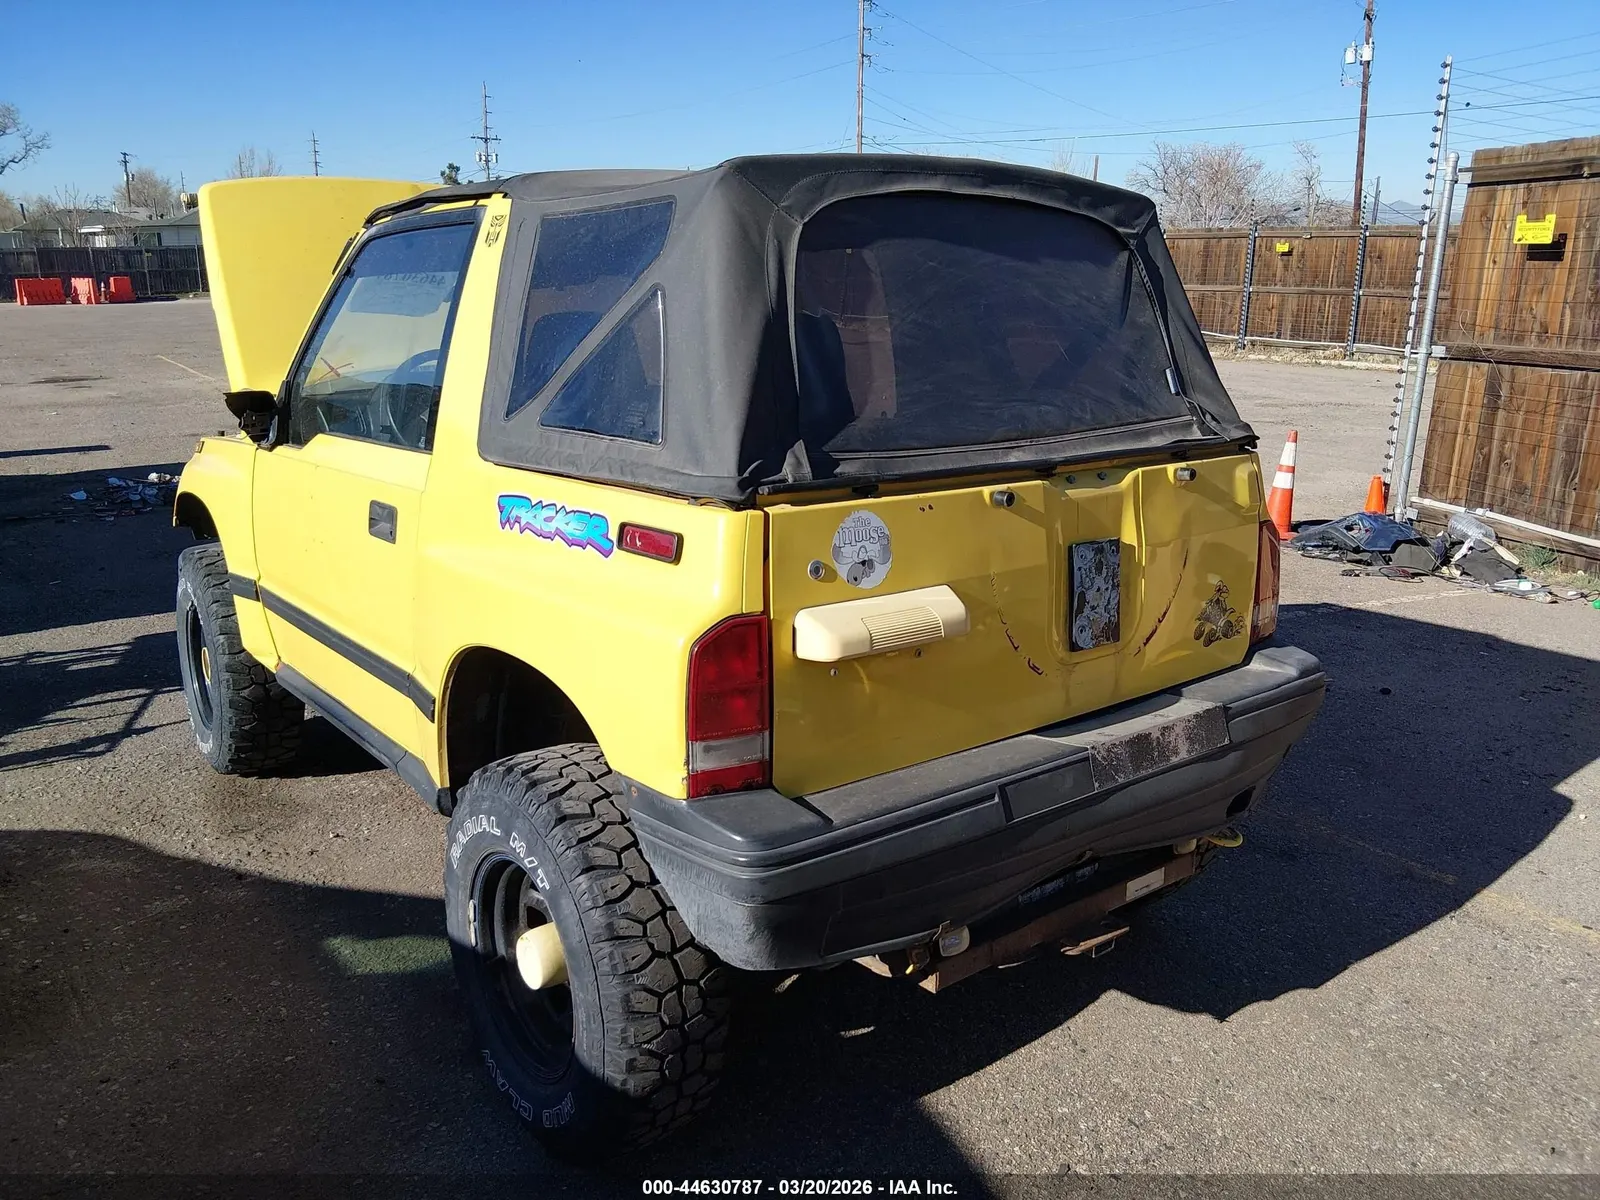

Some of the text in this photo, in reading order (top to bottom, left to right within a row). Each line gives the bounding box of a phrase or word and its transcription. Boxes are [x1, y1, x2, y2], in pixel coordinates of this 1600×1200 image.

[497, 494, 614, 559] TRACKER
[835, 525, 885, 548] Moose
[853, 515, 872, 528] The
[450, 814, 501, 869] RADIAL
[481, 1049, 575, 1128] MUD CLAW
